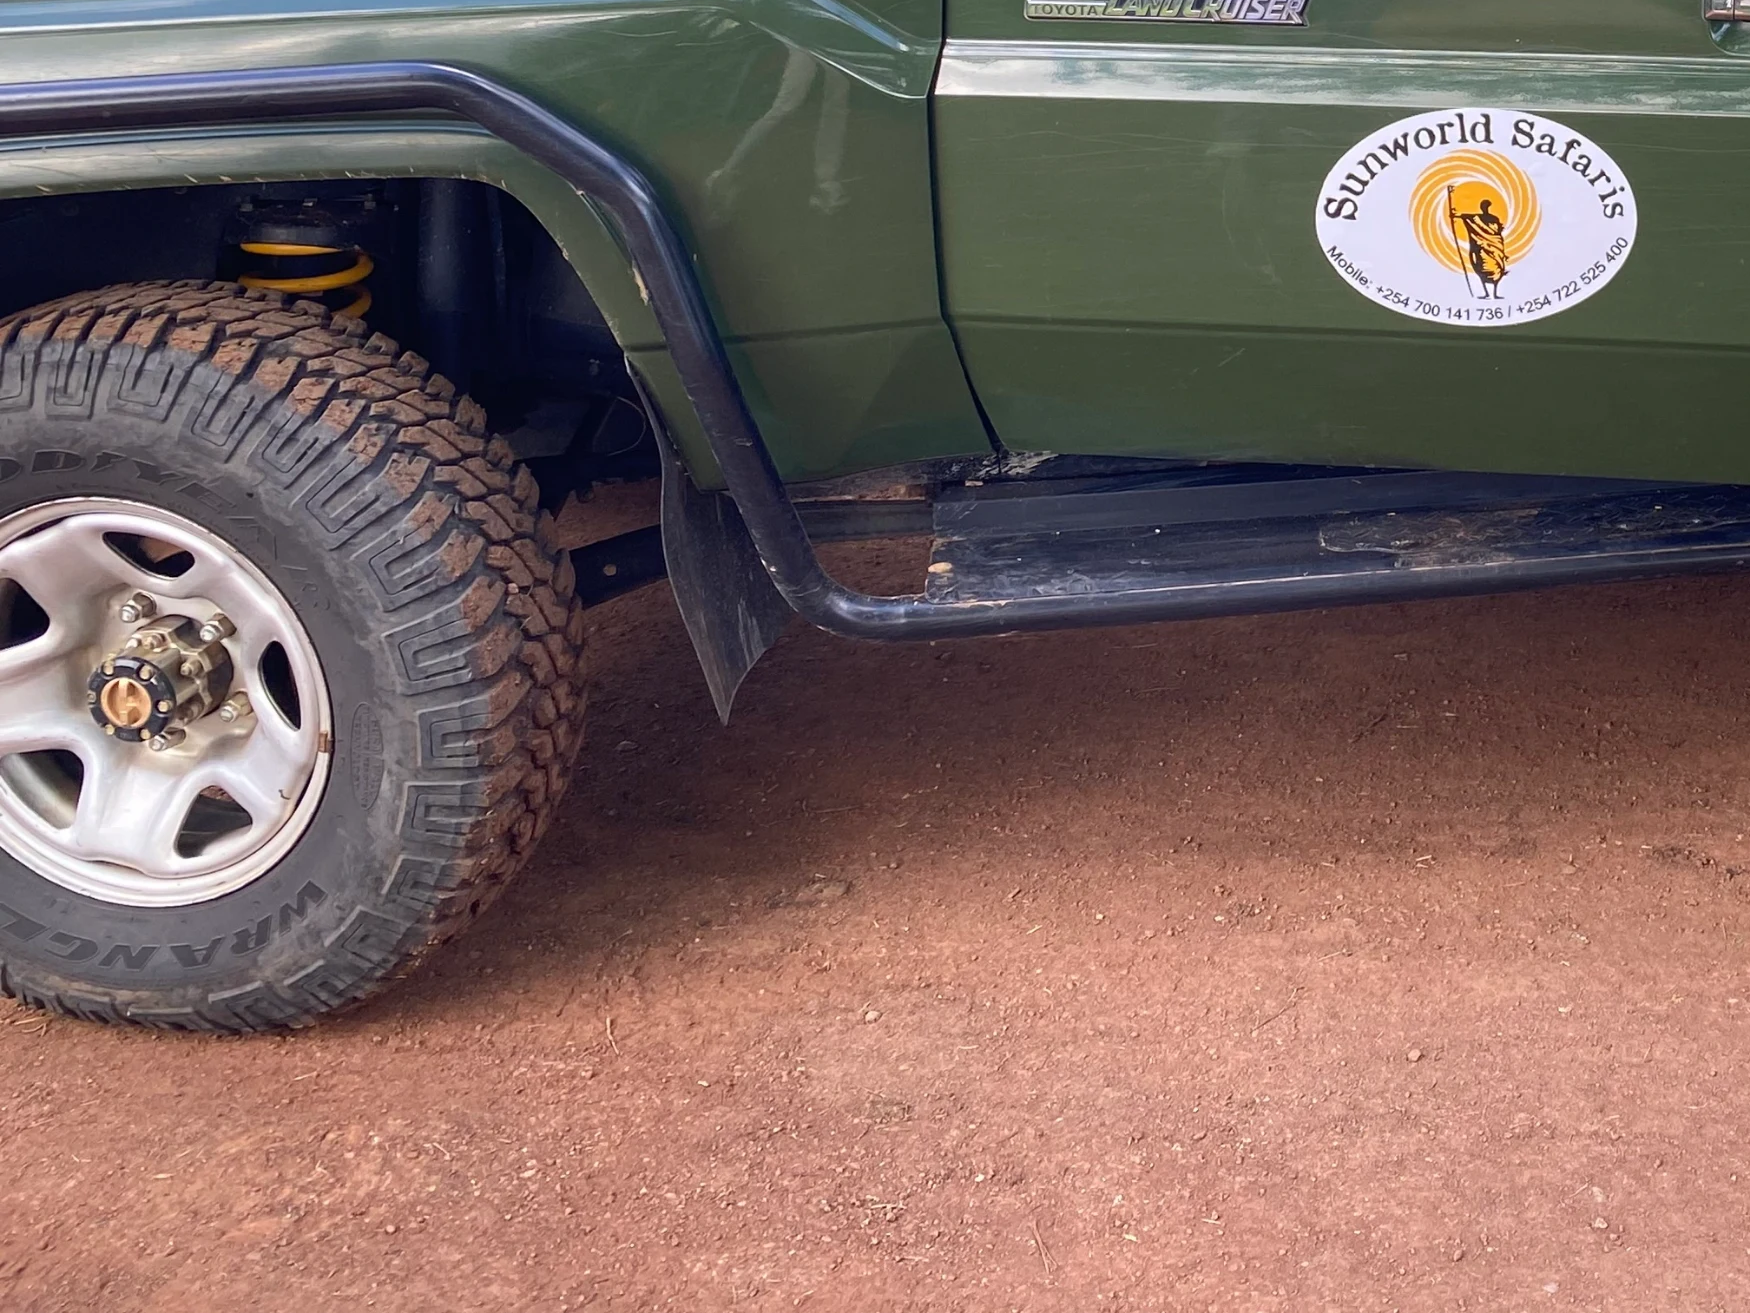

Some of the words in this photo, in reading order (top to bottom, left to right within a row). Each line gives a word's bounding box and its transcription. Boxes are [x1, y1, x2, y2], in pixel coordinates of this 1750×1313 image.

[1031, 3, 1099, 17] TOYOTA
[1323, 112, 1495, 221] Sunworld
[1511, 118, 1626, 220] Safaris
[1326, 245, 1373, 290] Mobile:
[1376, 286, 1410, 309] +254
[1414, 300, 1441, 317] 700
[1446, 307, 1471, 321] 141
[1476, 308, 1504, 321] 736
[1516, 294, 1551, 314] +254
[1552, 280, 1581, 302] 722
[1580, 260, 1606, 285] 525
[1605, 236, 1629, 264] 400
